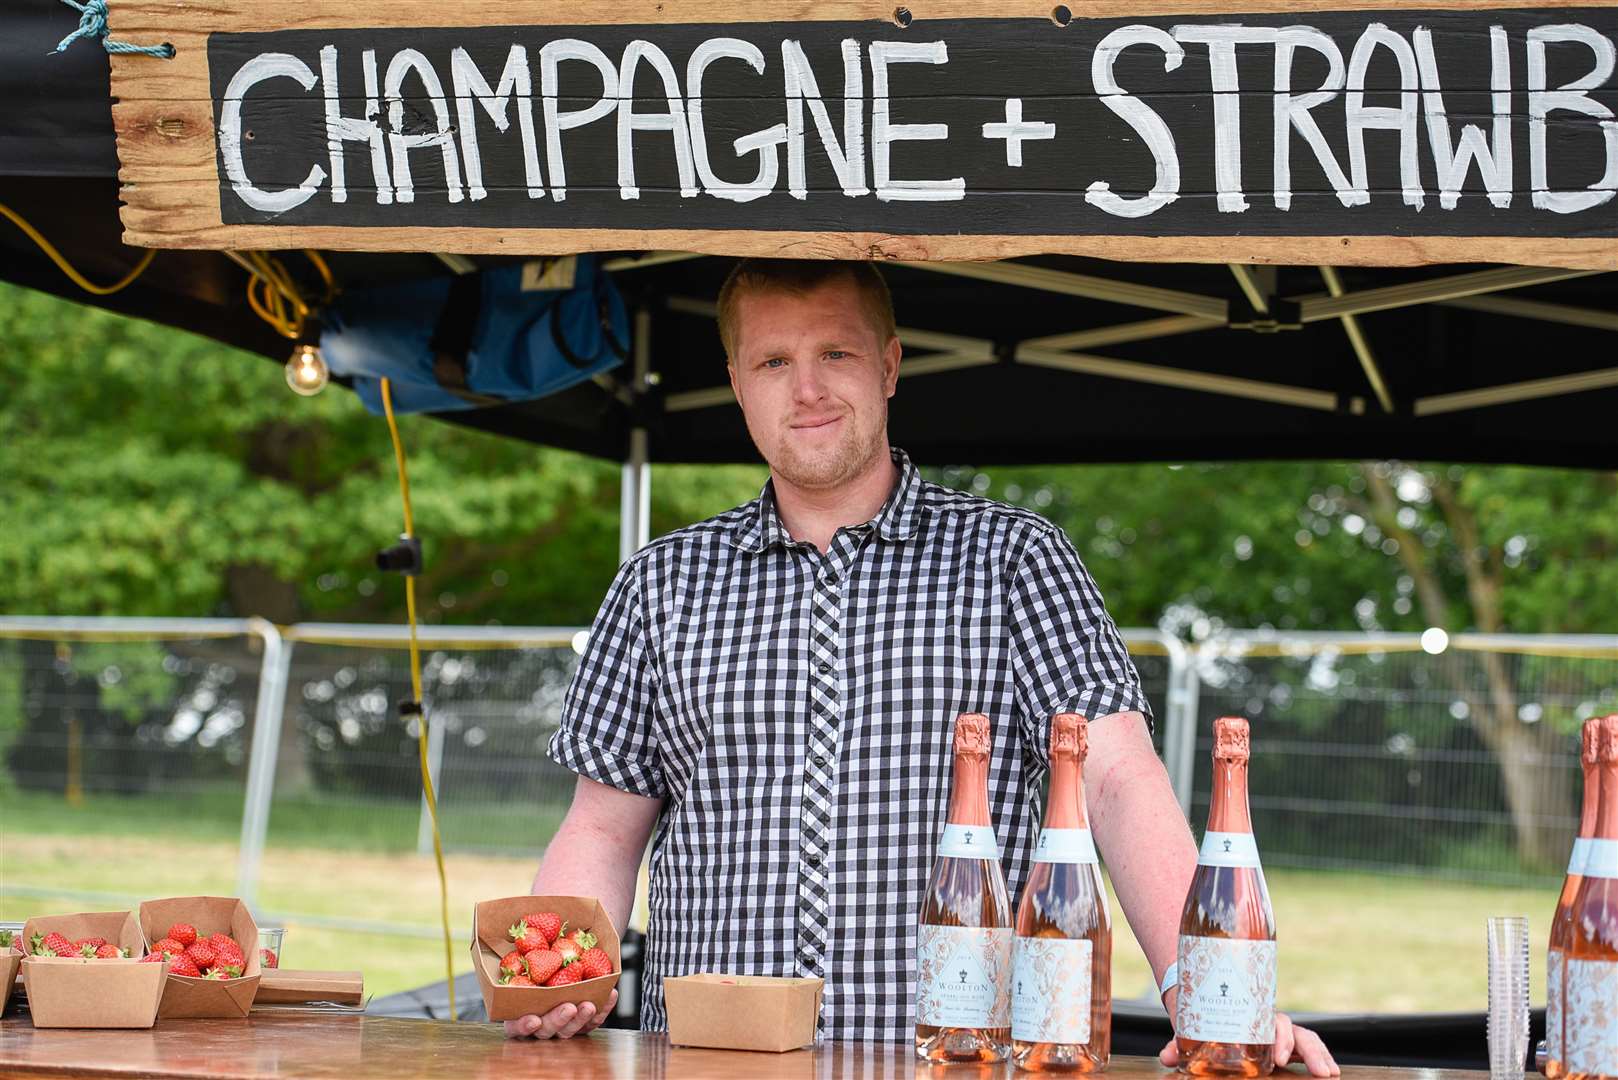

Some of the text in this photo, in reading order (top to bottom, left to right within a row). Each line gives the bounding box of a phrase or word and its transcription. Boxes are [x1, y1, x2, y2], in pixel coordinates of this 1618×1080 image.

[219, 22, 1618, 218] CHAMPAGNE + STRAWB
